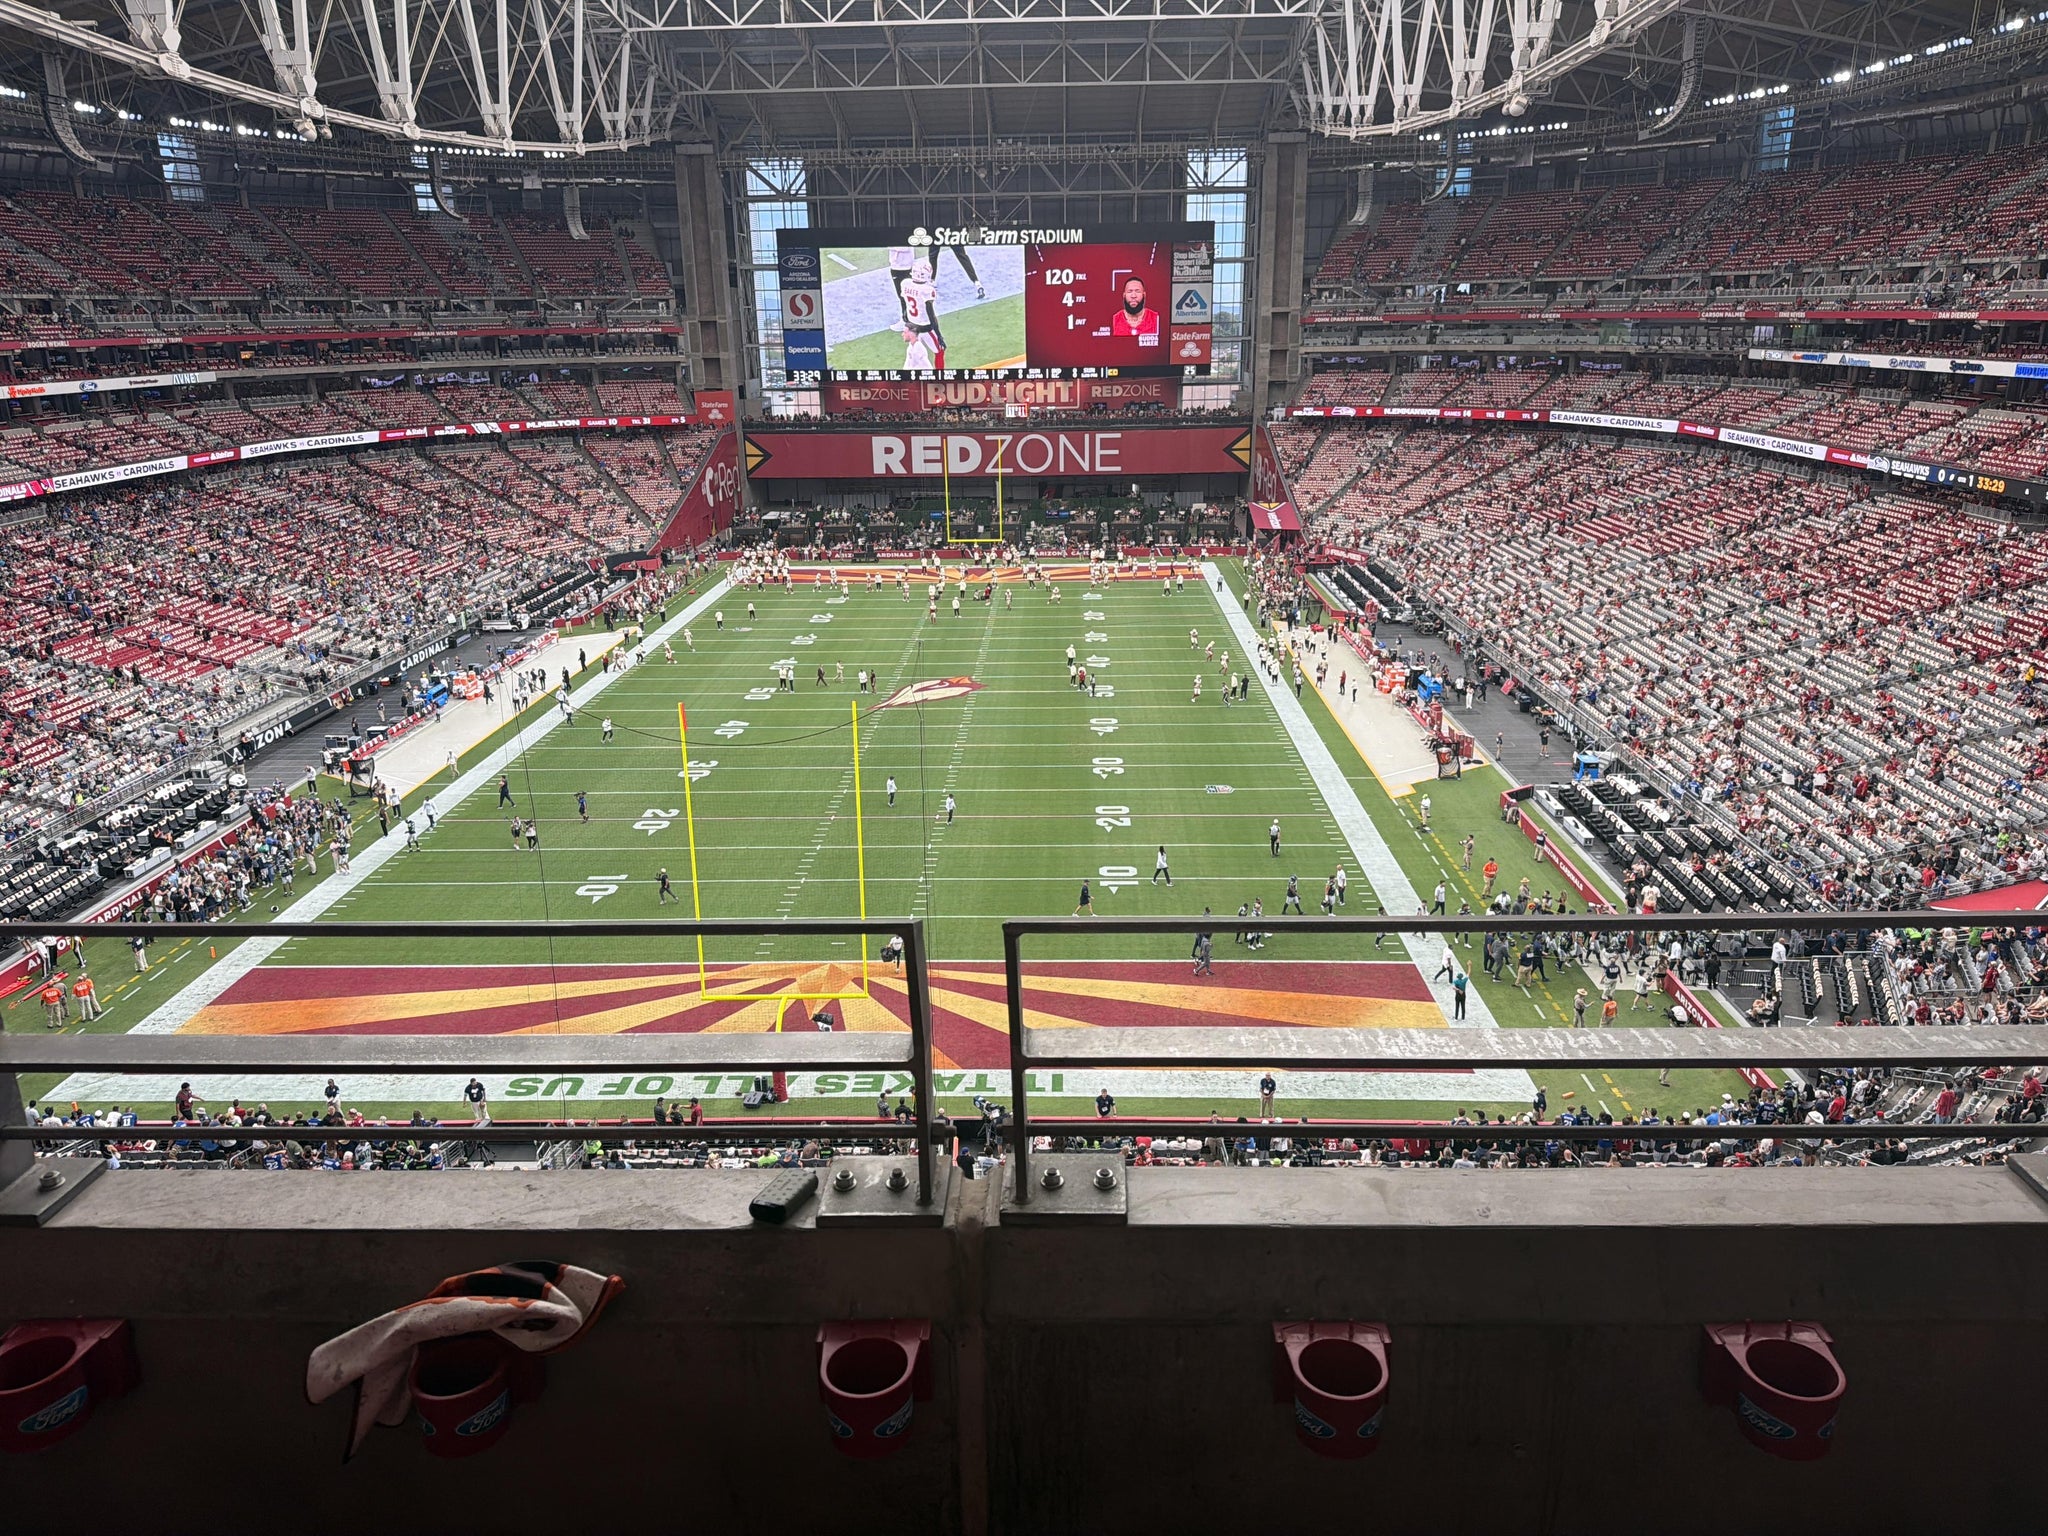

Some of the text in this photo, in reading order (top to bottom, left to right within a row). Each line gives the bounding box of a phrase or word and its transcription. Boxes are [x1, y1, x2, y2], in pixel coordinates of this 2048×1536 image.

[1020, 229, 1083, 244] STADIUM
[788, 256, 810, 266] Ford
[1046, 269, 1074, 285] 120
[907, 296, 918, 317] 3
[1062, 291, 1074, 306] 4
[1067, 314, 1074, 329] 1
[1192, 332, 1210, 340] Farm
[788, 346, 820, 355] Spectrum
[173, 373, 199, 384] AVNET
[793, 370, 821, 381] 33:29
[840, 387, 909, 400] REDZONE
[927, 381, 1073, 404] BUD LIGHT
[1092, 384, 1161, 398] REDZONE
[526, 419, 580, 428] M.MELTON
[1551, 413, 1662, 429] SEAHAWKS CARDINALS
[250, 434, 364, 455] SEAHAWKS CARDINALS
[1727, 432, 1814, 455] SEAHAWKS CARDINALS
[872, 433, 1122, 474] REDZONE
[55, 461, 174, 489] SEAHAWKS CARDINALS
[718, 456, 740, 501] Red
[1891, 461, 1930, 475] SEAHAWKS
[1938, 469, 1945, 482] 0
[1977, 477, 2005, 493] 33:29
[400, 638, 450, 672] CARDINALS
[744, 687, 777, 700] 50
[714, 720, 750, 735] 40
[1090, 718, 1118, 732] 40
[677, 760, 719, 778] 30
[1092, 757, 1124, 775] 30
[632, 808, 680, 830] 20
[1095, 805, 1132, 826] 20
[575, 874, 629, 896] 10
[1099, 866, 1139, 886] 10
[1675, 990, 1708, 1028] ARIZONA
[504, 1077, 585, 1097] US
[597, 1076, 674, 1095] OF
[814, 1074, 996, 1093] TAKES
